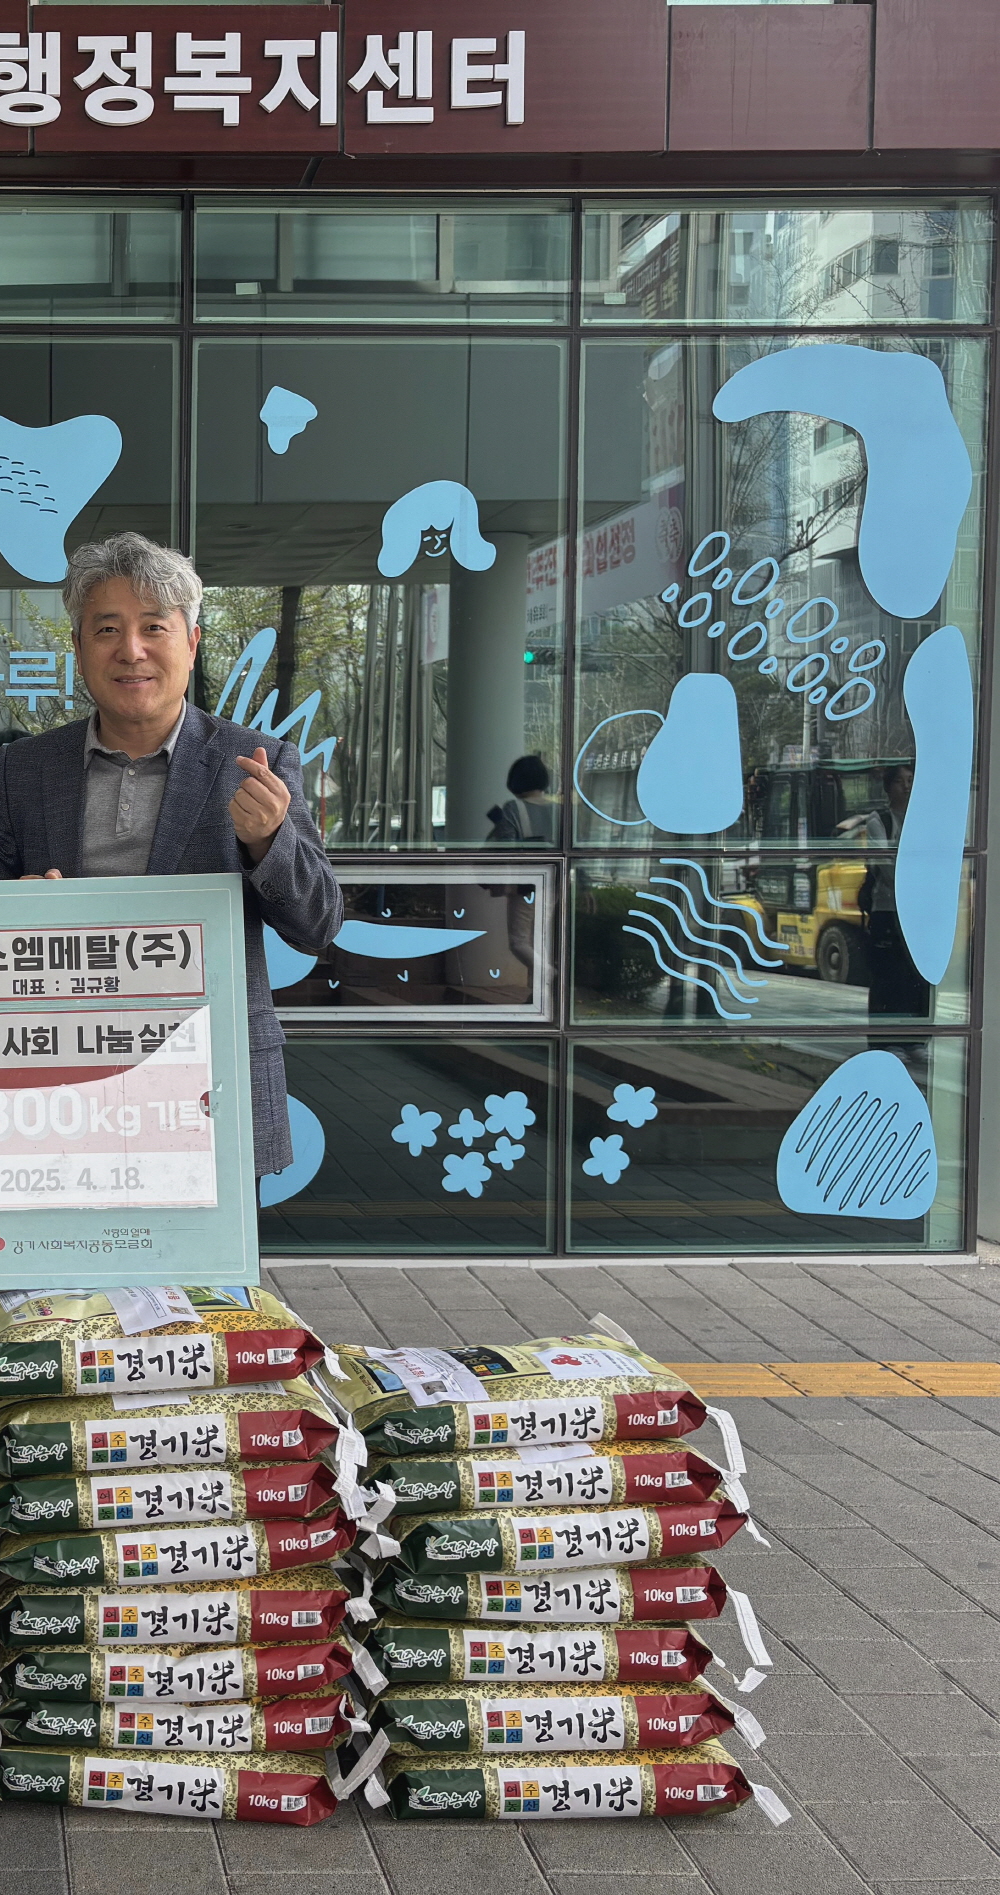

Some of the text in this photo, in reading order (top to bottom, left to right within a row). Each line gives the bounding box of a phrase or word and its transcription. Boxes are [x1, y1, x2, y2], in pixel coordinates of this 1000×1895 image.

[13, 978, 45, 995] 대표
[70, 976, 120, 994] 김규황
[77, 1022, 196, 1055] 나눔실천
[148, 1099, 208, 1131] 기탁
[0, 1166, 145, 1192] 2025. 4. 18.
[82, 1351, 112, 1365] 여주
[235, 1351, 265, 1365] 10kg
[1, 1360, 58, 1380] 여주농산
[82, 1369, 113, 1382] 농산
[475, 1415, 506, 1428] 여주
[626, 1412, 655, 1426] 10kg
[94, 1434, 125, 1446] 여주
[249, 1434, 280, 1448] 10kg
[475, 1432, 507, 1443] 농산
[93, 1450, 125, 1462] 농산
[480, 1474, 510, 1485] 여주
[633, 1474, 663, 1488] 10kg
[99, 1489, 129, 1502] 여주
[256, 1488, 286, 1503] 10kg
[399, 1481, 457, 1500] 여주농산
[480, 1489, 512, 1500] 농산
[99, 1506, 130, 1519] 농산
[521, 1530, 551, 1542] 여주
[669, 1523, 698, 1537] 10kg
[279, 1538, 310, 1552] 10kg
[442, 1538, 498, 1557] 여주농산
[124, 1546, 155, 1558] 여주
[522, 1546, 553, 1558] 농산
[125, 1563, 157, 1575] 농산
[488, 1582, 519, 1595] 여주
[643, 1588, 674, 1603] 10kg
[488, 1599, 519, 1610] 농산
[104, 1608, 136, 1621] 여주
[259, 1612, 289, 1626] 10kg
[104, 1625, 136, 1636] 농산
[471, 1643, 502, 1656] 여주
[629, 1651, 659, 1666] 10kg
[472, 1660, 502, 1672] 농산
[111, 1668, 142, 1681] 여주
[264, 1668, 295, 1682] 10kg
[30, 1673, 87, 1690] 여주농산
[110, 1685, 142, 1695] 농산
[121, 1715, 152, 1728] 여주
[489, 1712, 520, 1726] 여주
[646, 1718, 677, 1733] 10kg
[272, 1721, 303, 1735] 10kg
[120, 1732, 152, 1743] 농산
[489, 1730, 520, 1742] 농산
[91, 1773, 122, 1785] 여주
[90, 1789, 121, 1799] 농산
[506, 1782, 538, 1796] 여주
[664, 1787, 695, 1801] 10kg
[247, 1795, 279, 1808] 10kg
[423, 1790, 482, 1809] 여주농산
[506, 1800, 538, 1811] 농산
